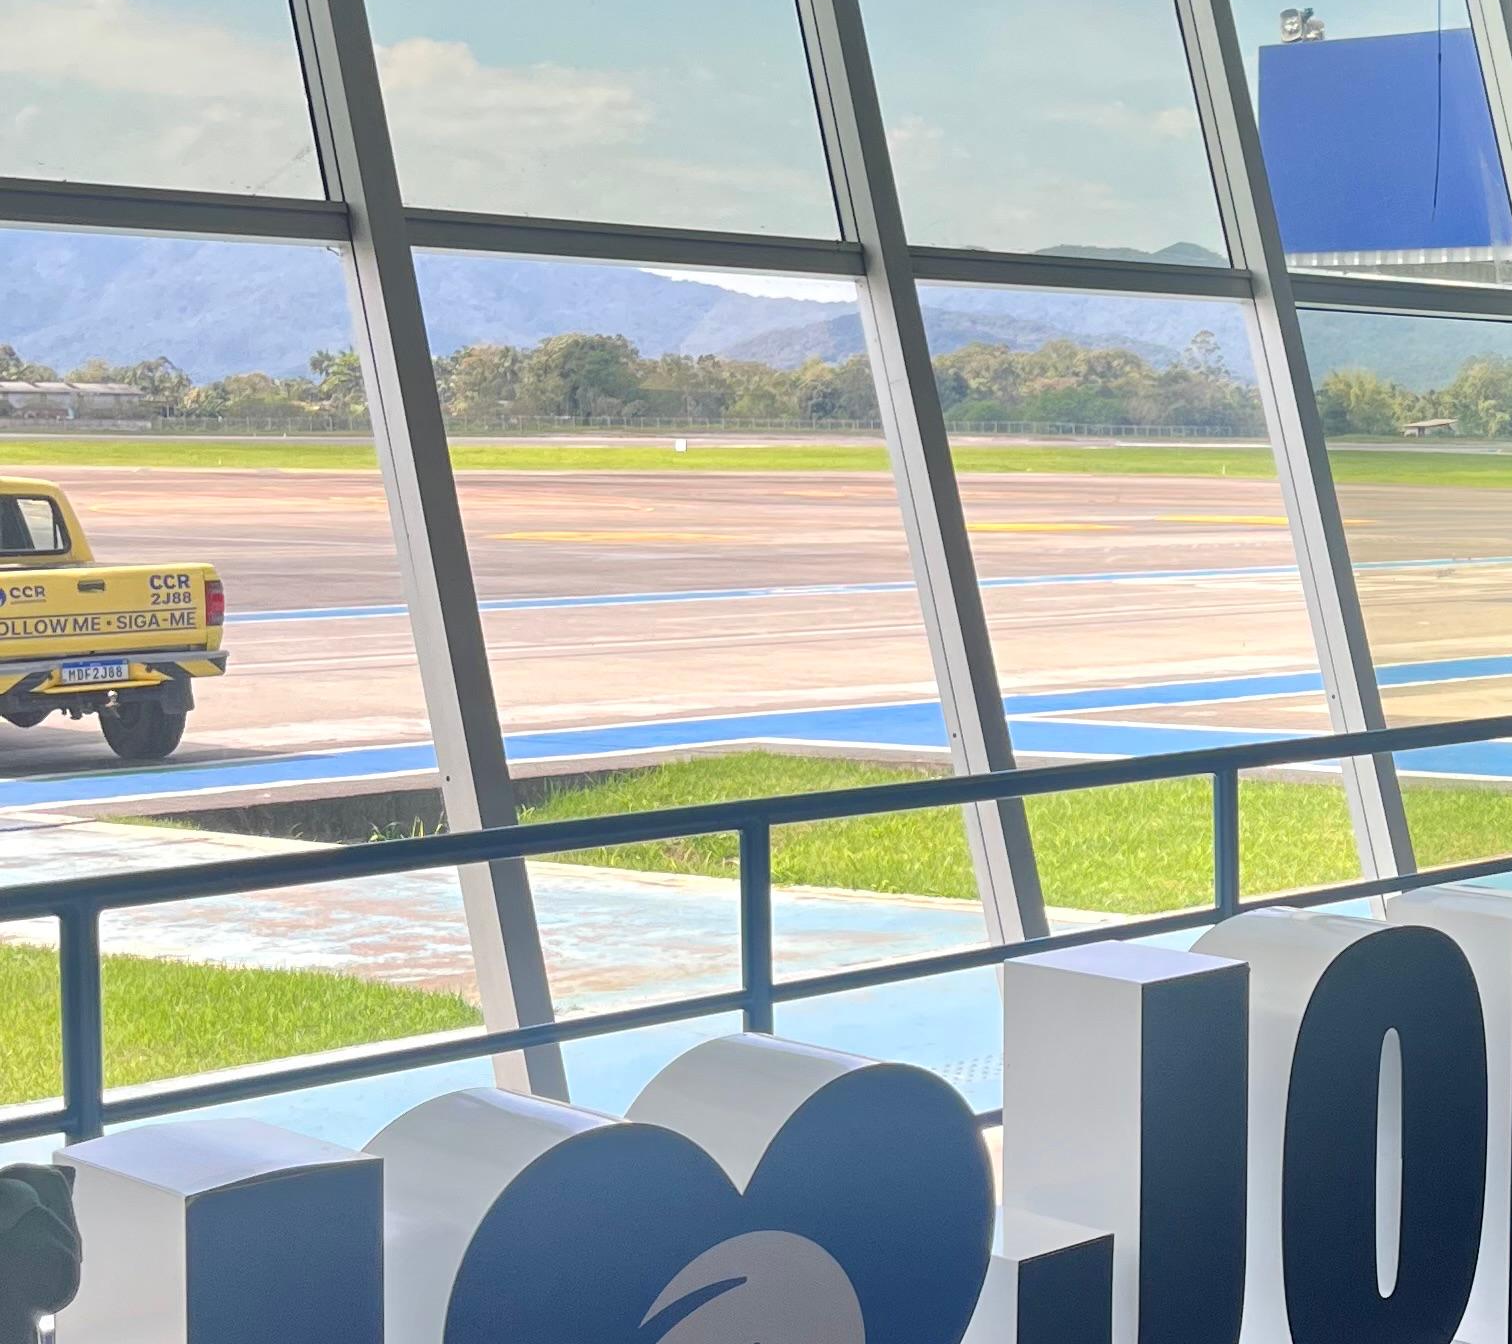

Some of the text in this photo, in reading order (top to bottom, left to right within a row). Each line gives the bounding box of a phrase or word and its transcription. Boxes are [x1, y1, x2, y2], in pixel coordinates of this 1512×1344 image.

[149, 574, 191, 590] CCR
[9, 586, 46, 599] CCR
[150, 591, 192, 605] 2J88
[0, 611, 197, 636] OLLOW ME SIGA-ME
[68, 666, 123, 681] MDF2J88
